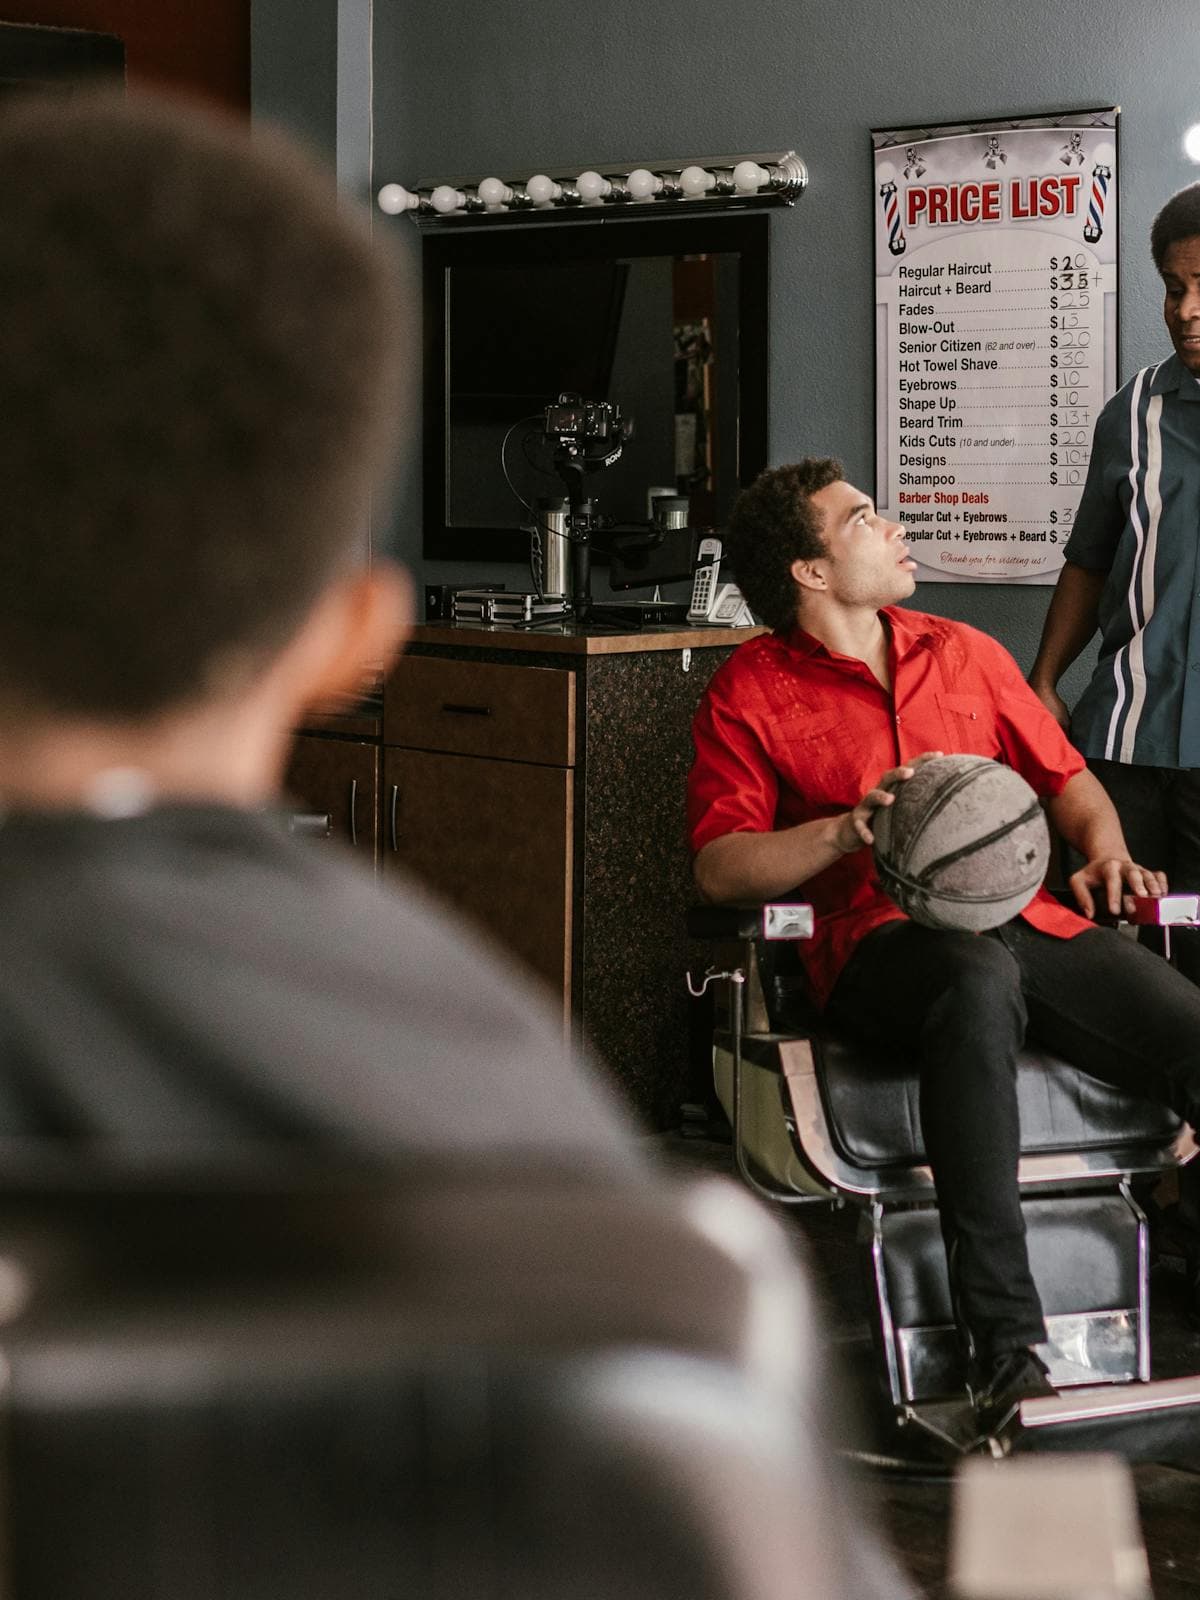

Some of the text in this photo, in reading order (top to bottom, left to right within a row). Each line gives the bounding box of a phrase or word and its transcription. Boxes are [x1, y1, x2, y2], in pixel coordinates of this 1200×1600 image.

[908, 177, 1080, 225] PRICE LIST
[899, 265, 944, 280] Regular
[948, 262, 992, 276] Haircut
[899, 284, 941, 297] Haircut
[944, 286, 952, 295] +
[956, 281, 992, 294] Beard
[899, 304, 935, 316] Fades
[899, 321, 955, 335] Blow-Out
[899, 341, 937, 353] Senior
[940, 340, 982, 352] Citizen
[999, 341, 1015, 351] and
[1016, 340, 1036, 351] over)
[899, 360, 920, 372] Hot
[923, 359, 957, 371] Towel
[961, 358, 998, 371] Shave
[899, 379, 957, 394] Eyebrows
[899, 397, 936, 412] Shape
[939, 396, 956, 412] Up
[899, 416, 934, 429] Beard
[937, 416, 963, 428] Trim
[899, 435, 925, 447] Kids
[929, 435, 956, 447] Cuts
[973, 438, 989, 447] and
[990, 437, 1015, 448] under)
[899, 454, 947, 469] Designs
[899, 472, 956, 487] Shampoo
[899, 492, 989, 506] Barber Shop Deals
[899, 511, 934, 524] Regular
[936, 511, 952, 522] Cut
[954, 514, 960, 522] +
[963, 511, 1008, 524] Eyebrows
[902, 529, 934, 542] egular
[936, 529, 952, 540] Cut
[954, 532, 960, 541] +
[963, 530, 1008, 543] Eyebrows
[1010, 533, 1017, 541] +
[1020, 531, 1047, 541] Beard
[940, 551, 968, 564] Thank
[968, 557, 982, 566] you
[983, 555, 996, 566] for
[998, 556, 1029, 567] visiting
